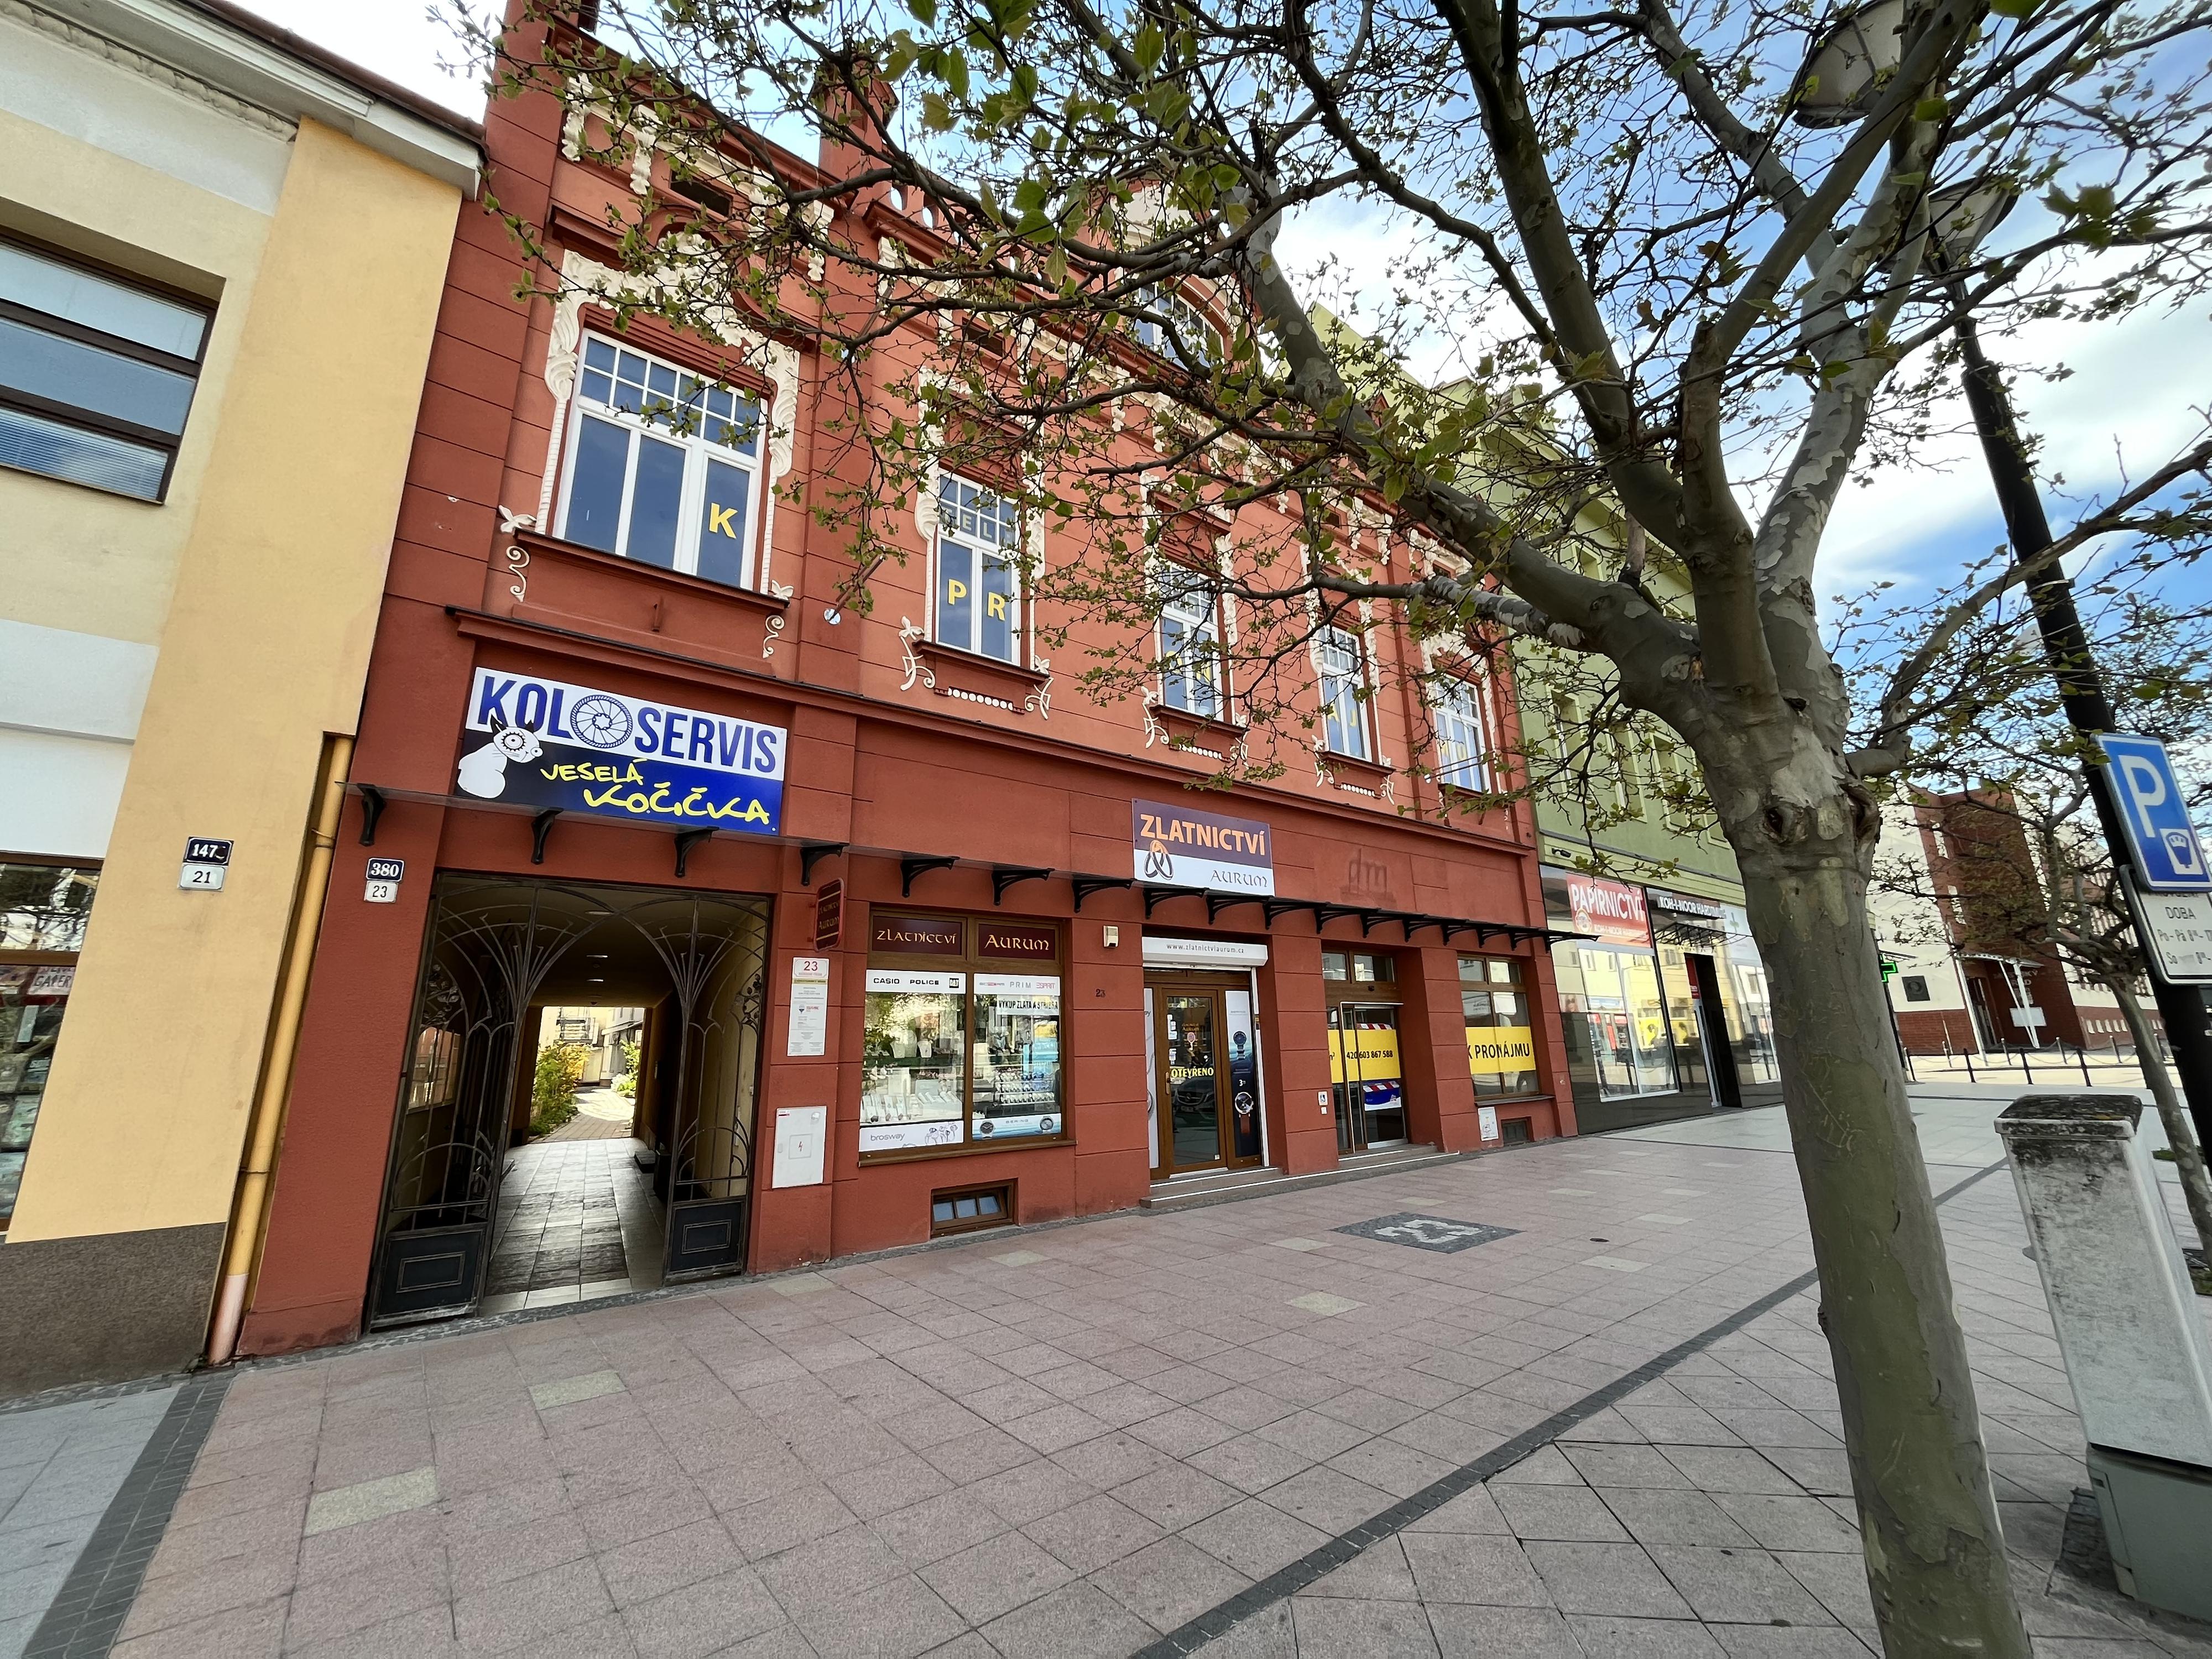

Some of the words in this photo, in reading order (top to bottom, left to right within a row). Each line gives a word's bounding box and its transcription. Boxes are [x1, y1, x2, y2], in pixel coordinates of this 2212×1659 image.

[708, 502, 737, 539] K
[2117, 754, 2166, 838] P
[1140, 813, 1266, 856] ZLATNICTVÍ
[192, 870, 211, 884] 21
[371, 863, 399, 877] 380
[372, 885, 388, 898] 23
[1570, 883, 1645, 922] PAPÍRNICTVÍ
[2165, 906, 2197, 919] DOBA
[804, 961, 818, 971] 23
[1095, 989, 1105, 998] 23
[1474, 1041, 1531, 1059] PRONÁJMU
[870, 1132, 905, 1142] brosway
